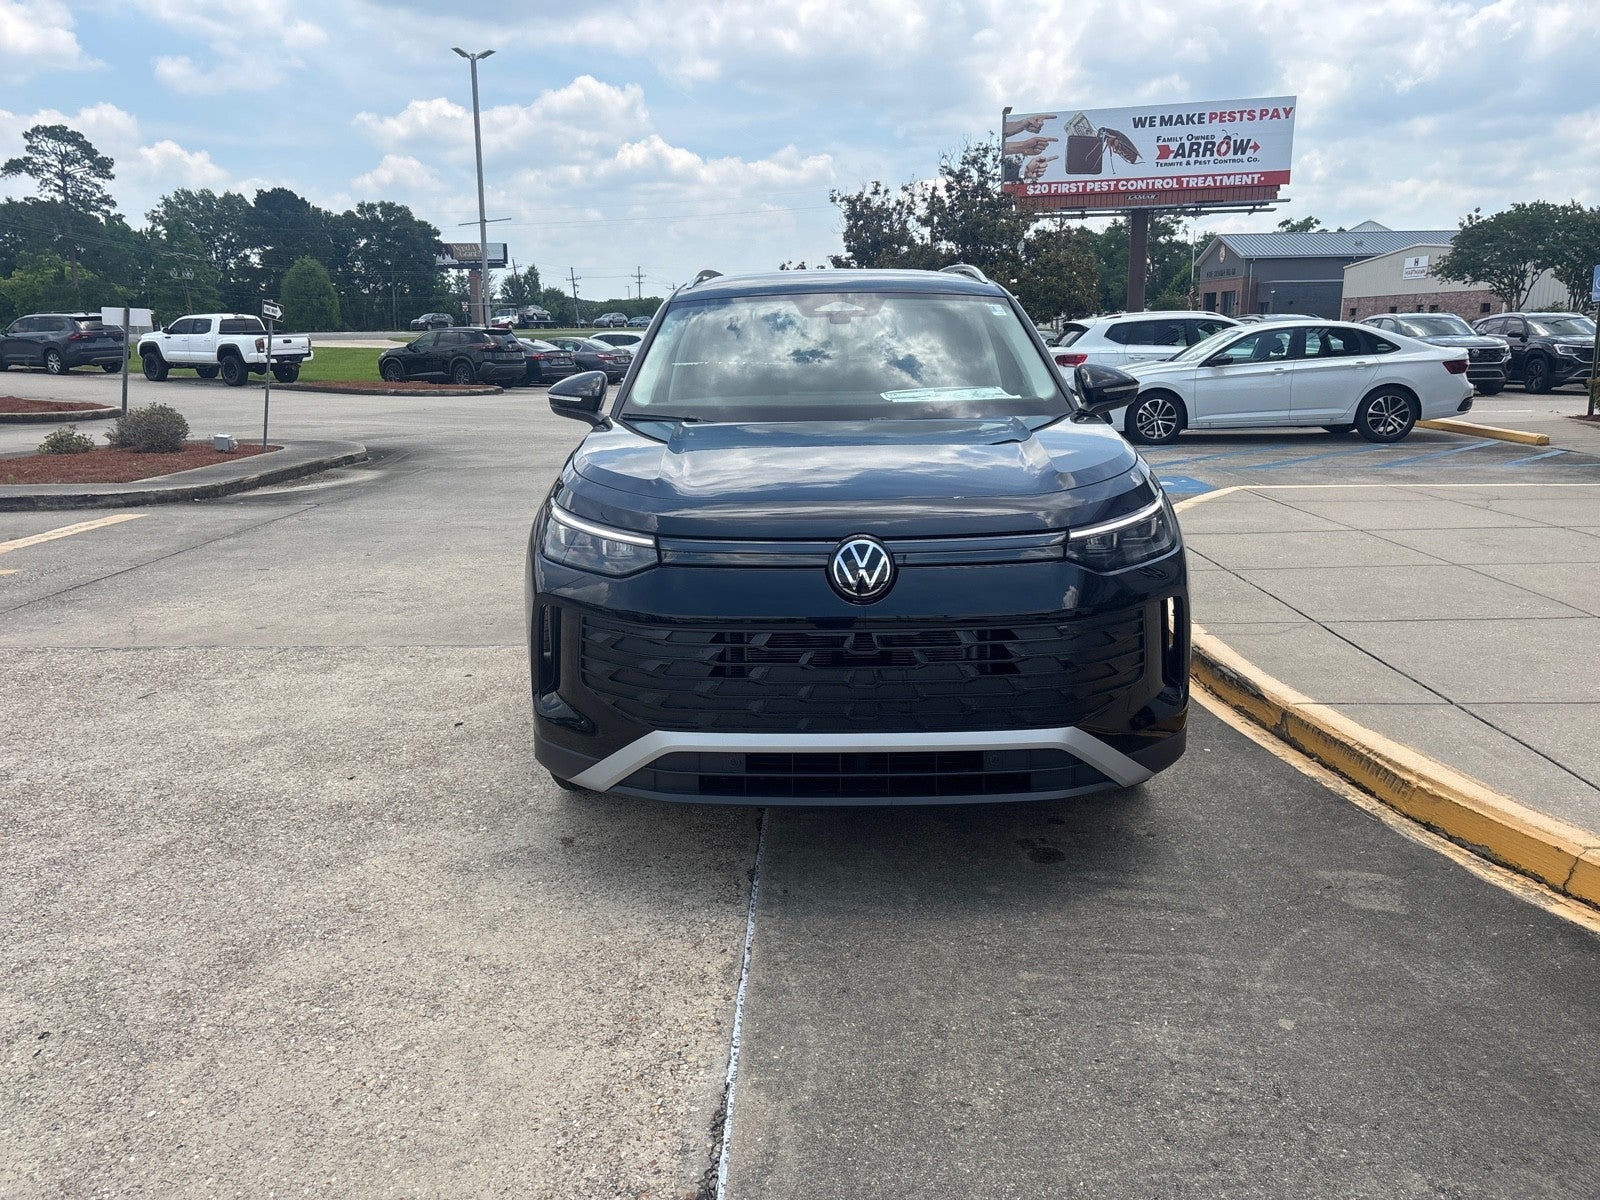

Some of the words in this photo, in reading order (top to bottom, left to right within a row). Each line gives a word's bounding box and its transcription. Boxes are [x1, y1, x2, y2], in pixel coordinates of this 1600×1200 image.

[1132, 115, 1157, 129] WE
[1159, 112, 1206, 127] MAKE
[1208, 109, 1257, 124] PESTS
[1259, 106, 1294, 121] PAY
[1172, 138, 1252, 159] ARROW
[1026, 183, 1049, 196] $20
[1051, 182, 1085, 194] FIRST
[1086, 180, 1117, 193] PEST
[1118, 177, 1179, 191] CONTROL
